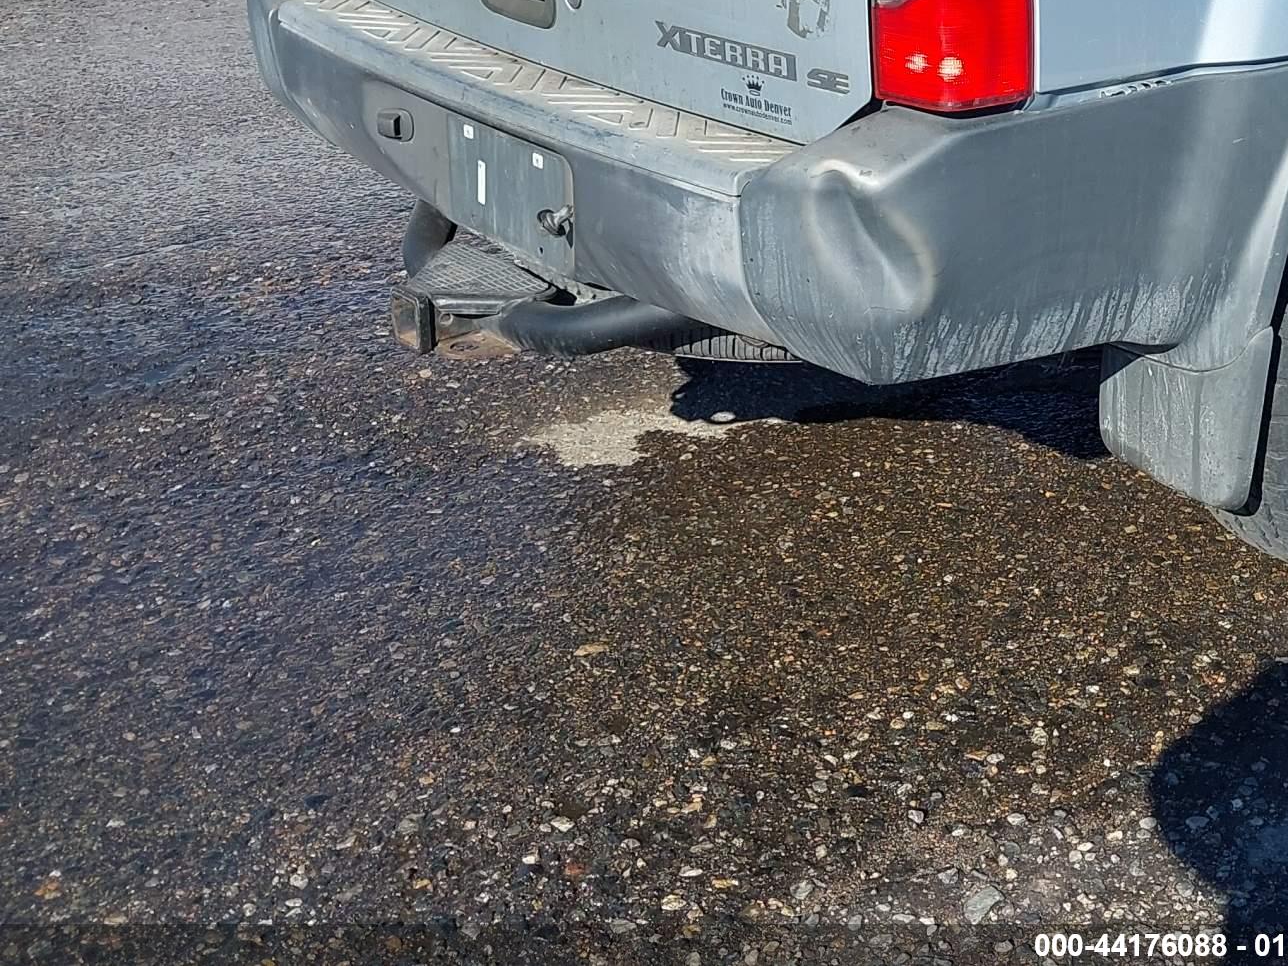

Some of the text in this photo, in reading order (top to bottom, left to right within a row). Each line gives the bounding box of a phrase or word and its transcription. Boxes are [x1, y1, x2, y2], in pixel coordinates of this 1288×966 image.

[655, 21, 850, 95] XTERRA SE
[721, 88, 791, 117] Crown Auto Denver
